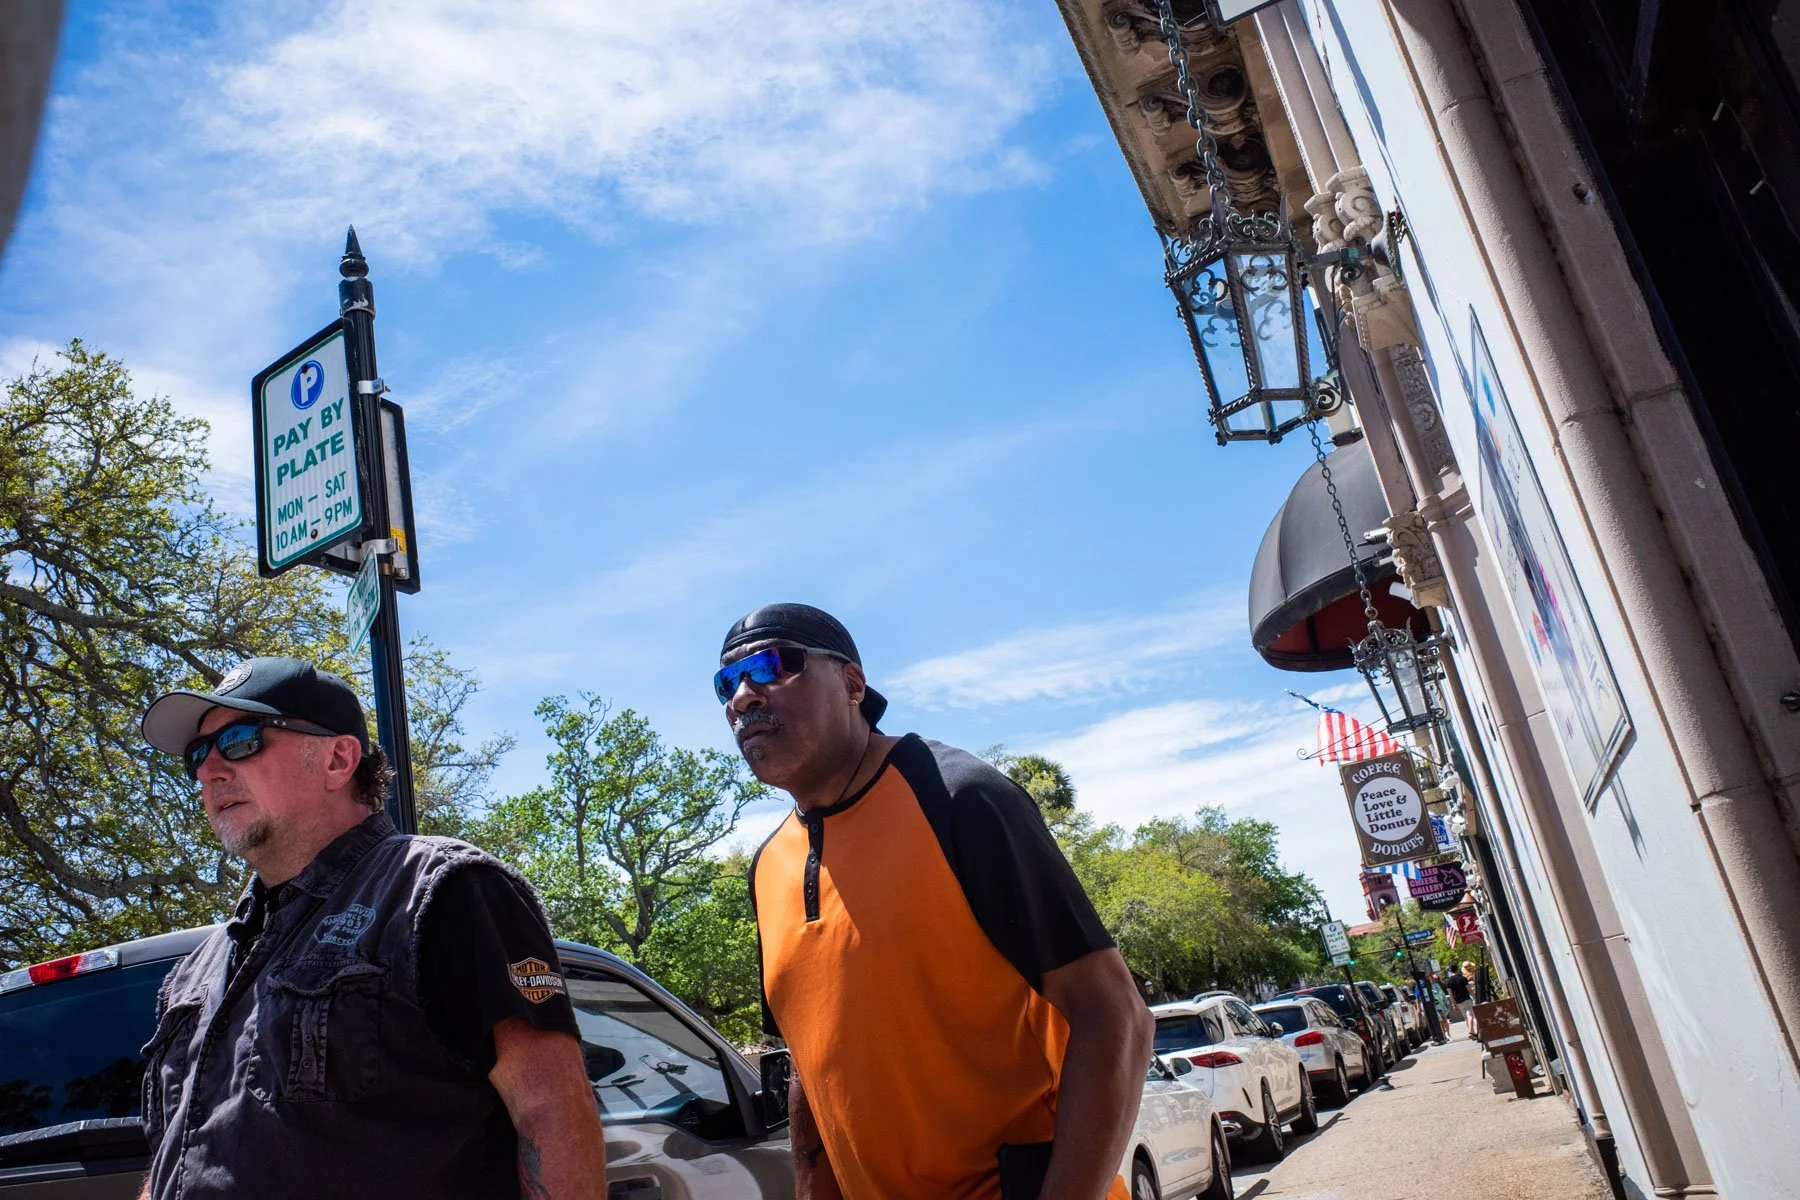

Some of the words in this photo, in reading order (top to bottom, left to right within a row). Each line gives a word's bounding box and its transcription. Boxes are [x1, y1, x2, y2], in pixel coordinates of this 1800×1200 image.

[273, 416, 312, 457] PAY
[320, 397, 344, 430] BY
[276, 430, 345, 487] PLATE
[277, 495, 303, 526] MON
[325, 470, 347, 499] SAT
[1352, 762, 1401, 784] COFFEE
[1361, 787, 1397, 802] Peace
[1363, 799, 1394, 813] Love
[1396, 794, 1408, 805] &
[1366, 808, 1403, 823] Little
[1369, 817, 1417, 834] Donuts
[1371, 832, 1425, 856] DONUTS
[1409, 876, 1438, 888] CHEESE
[1411, 882, 1444, 896] GALLERY
[514, 960, 546, 973] MOTOR
